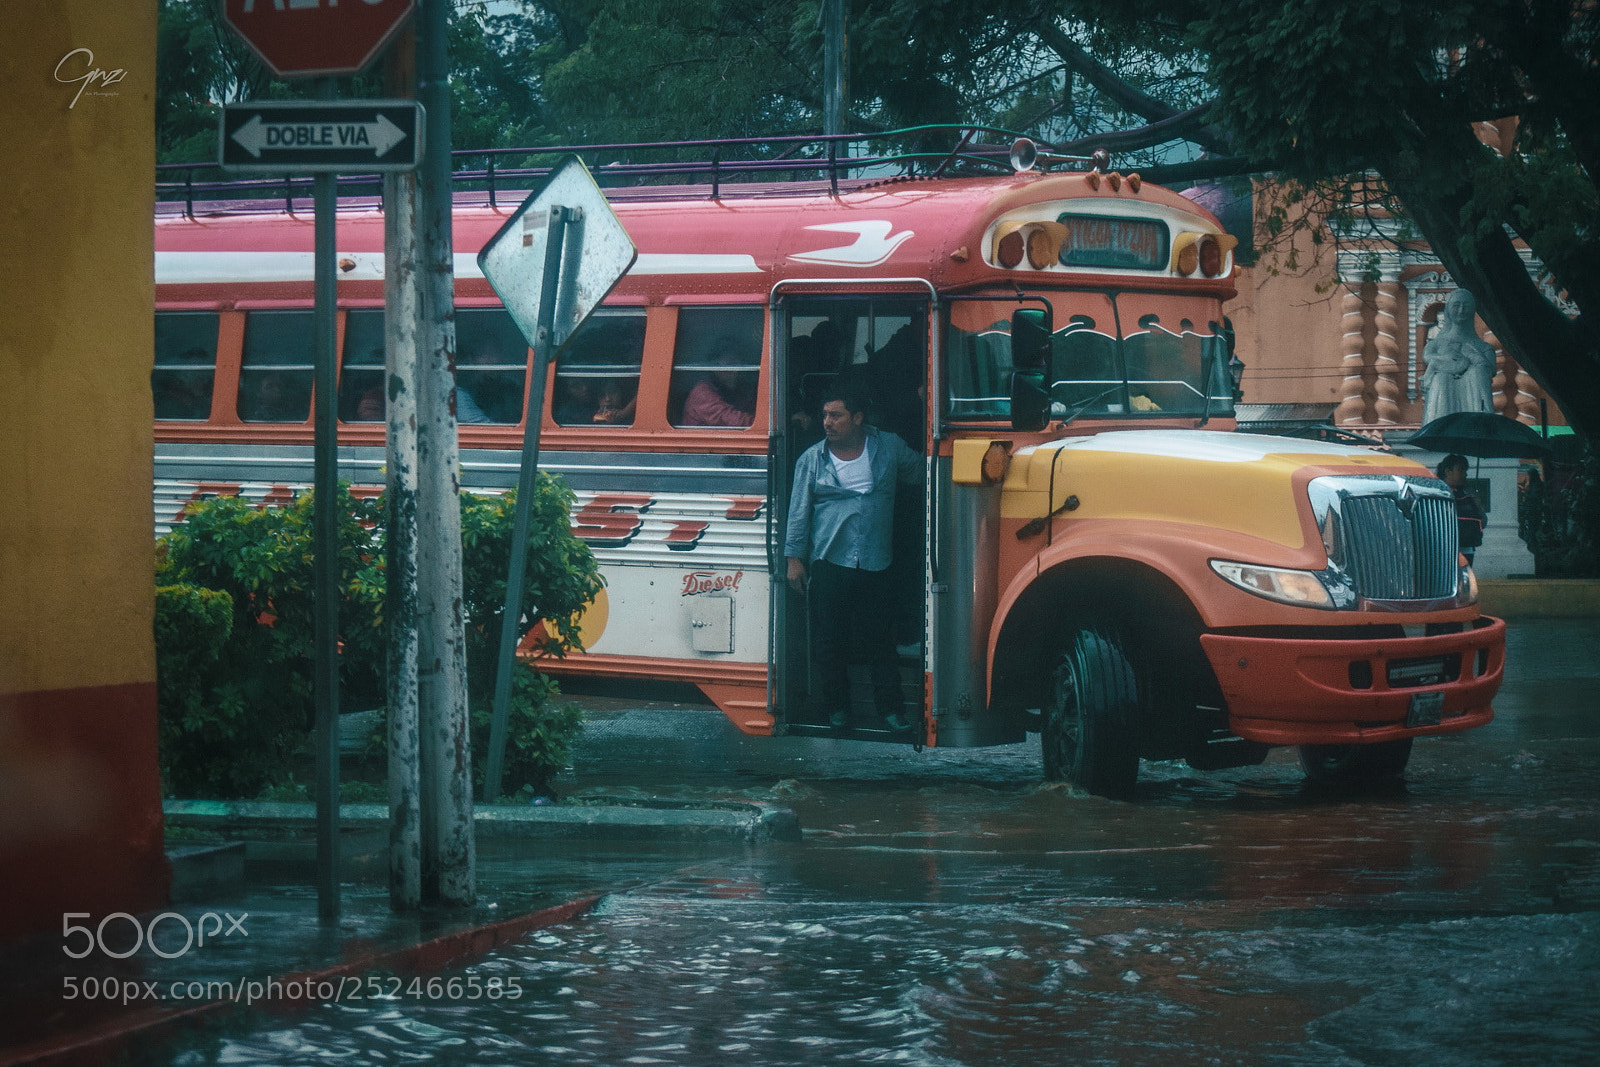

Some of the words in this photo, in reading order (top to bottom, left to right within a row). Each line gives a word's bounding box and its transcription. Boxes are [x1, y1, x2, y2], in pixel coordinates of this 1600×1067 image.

[266, 125, 334, 146] DOBLE
[337, 125, 370, 146] VIA
[681, 570, 744, 597] Diesel
